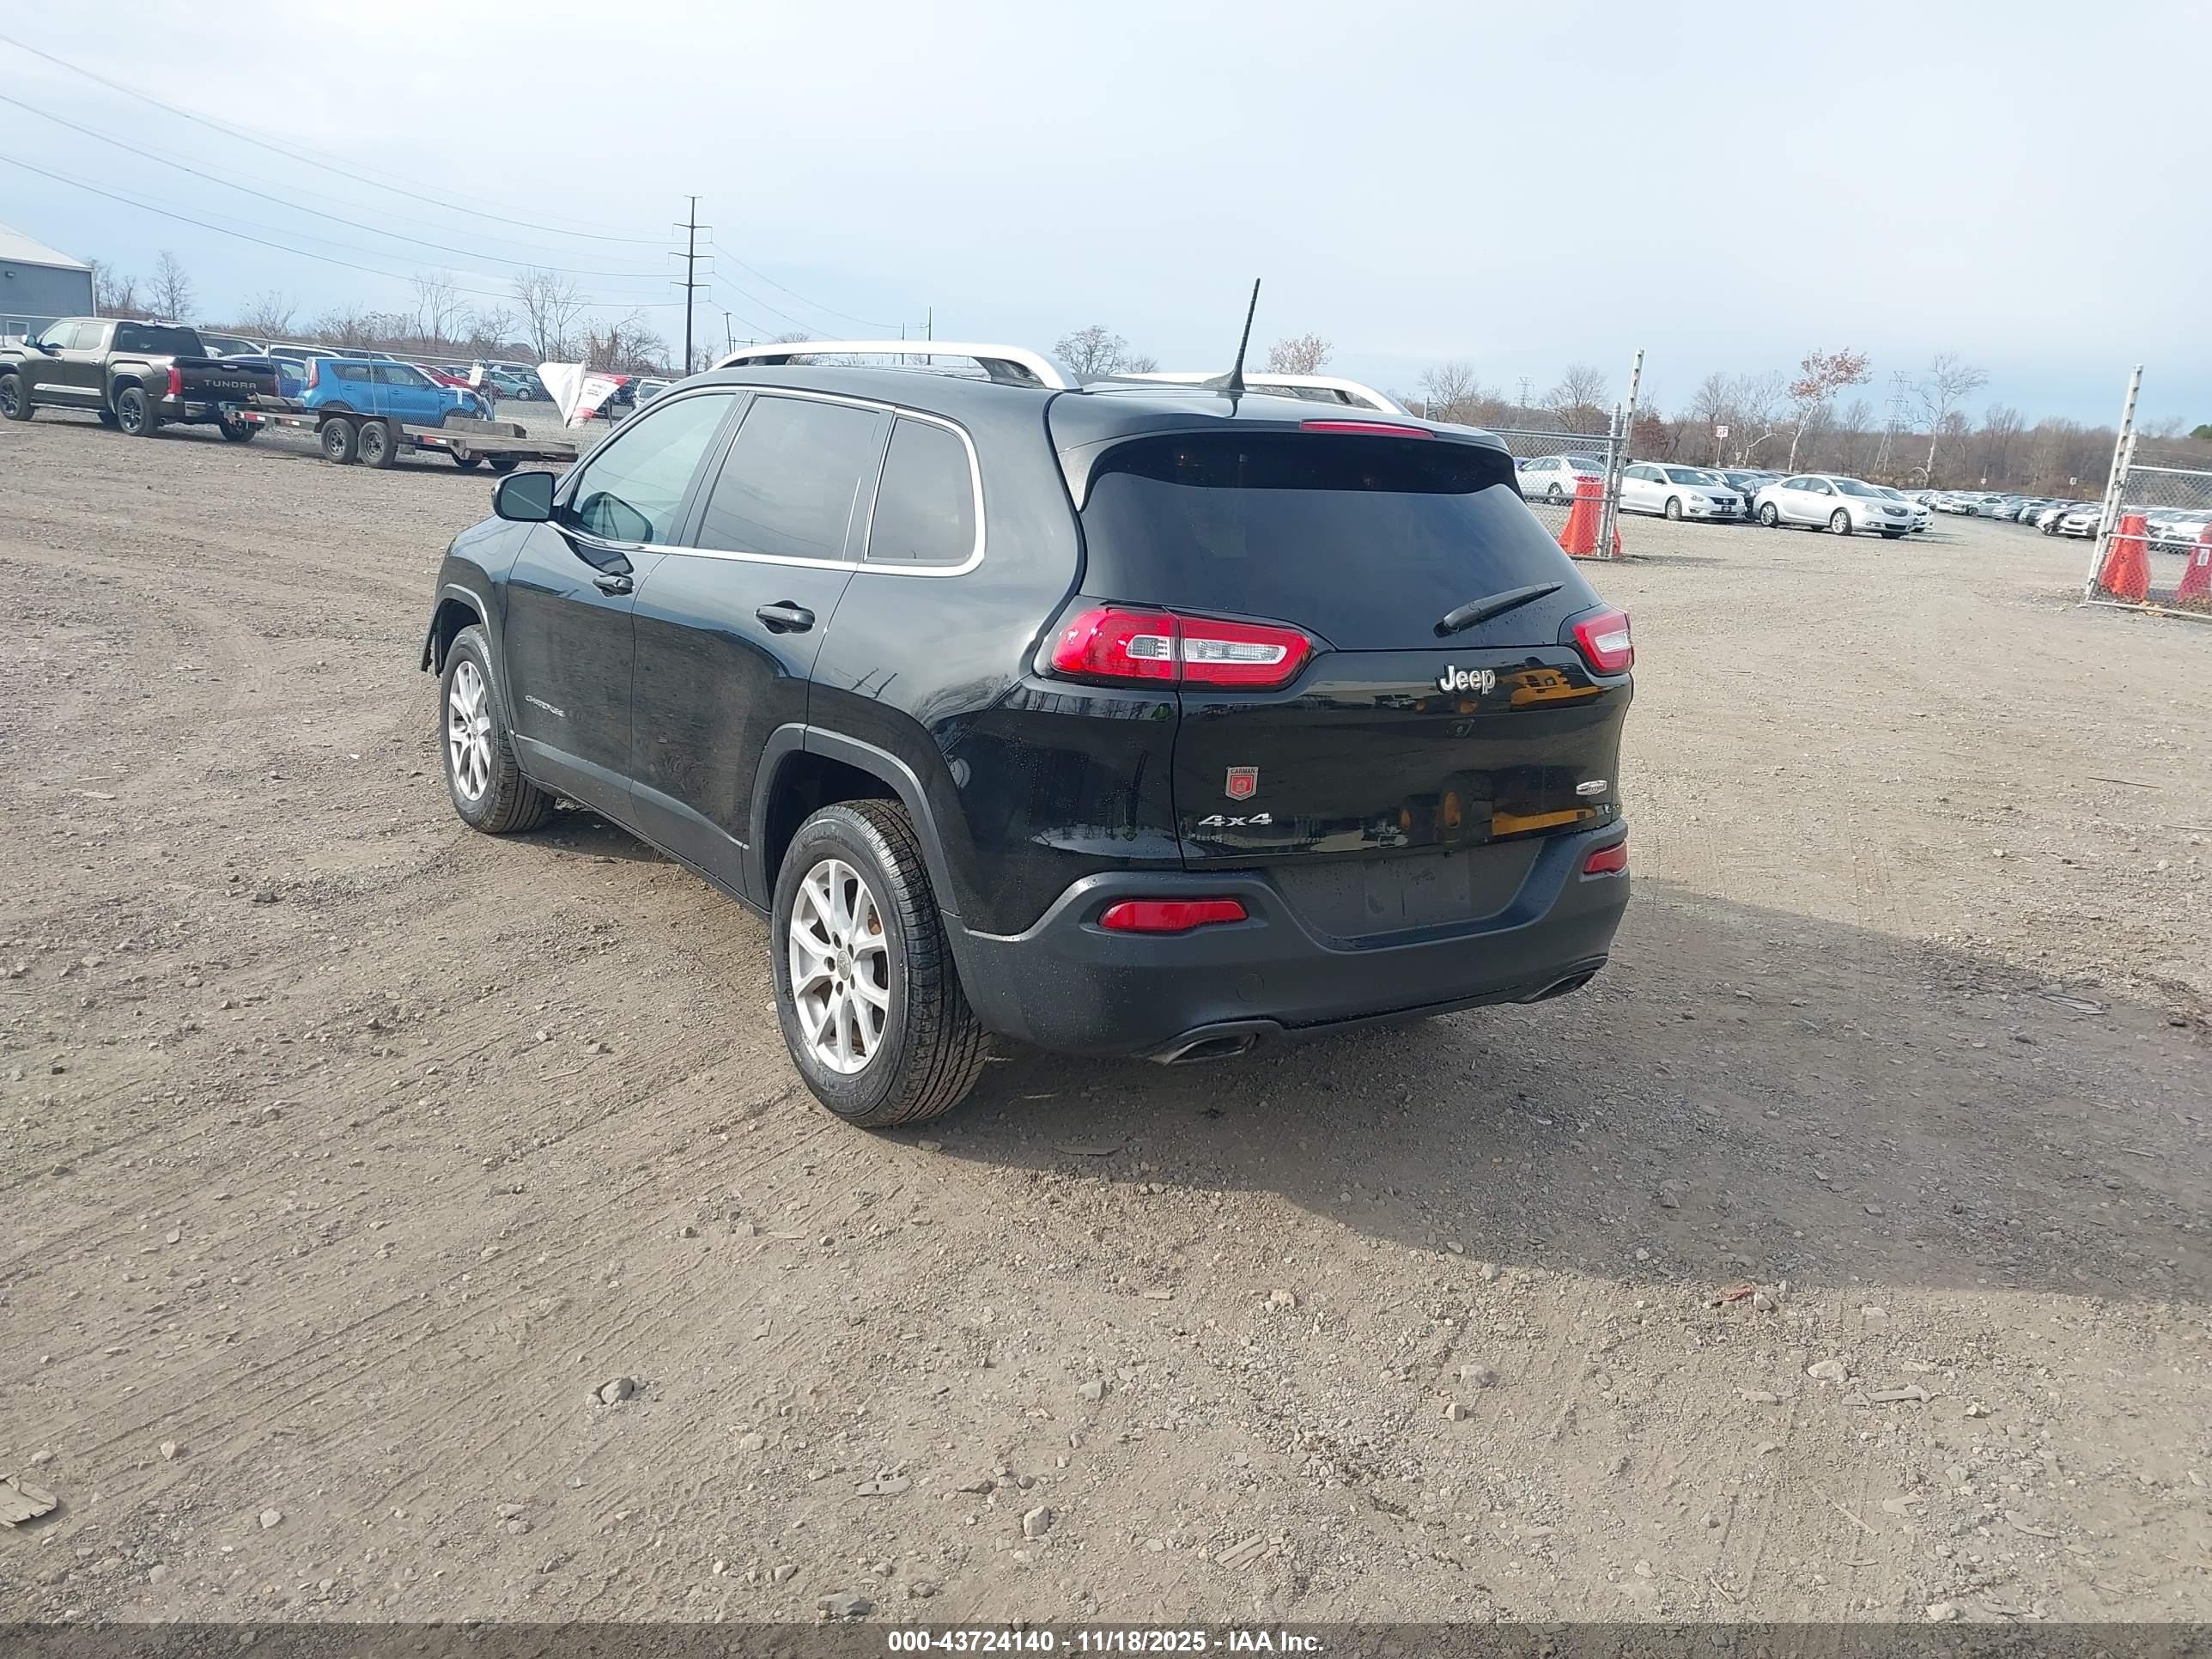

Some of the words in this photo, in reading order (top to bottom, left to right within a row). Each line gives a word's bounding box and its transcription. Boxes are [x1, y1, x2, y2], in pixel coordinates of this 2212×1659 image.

[204, 380, 257, 390] TUNDRA
[1439, 665, 1496, 696] Jeep
[1197, 811, 1273, 827] 4x4
